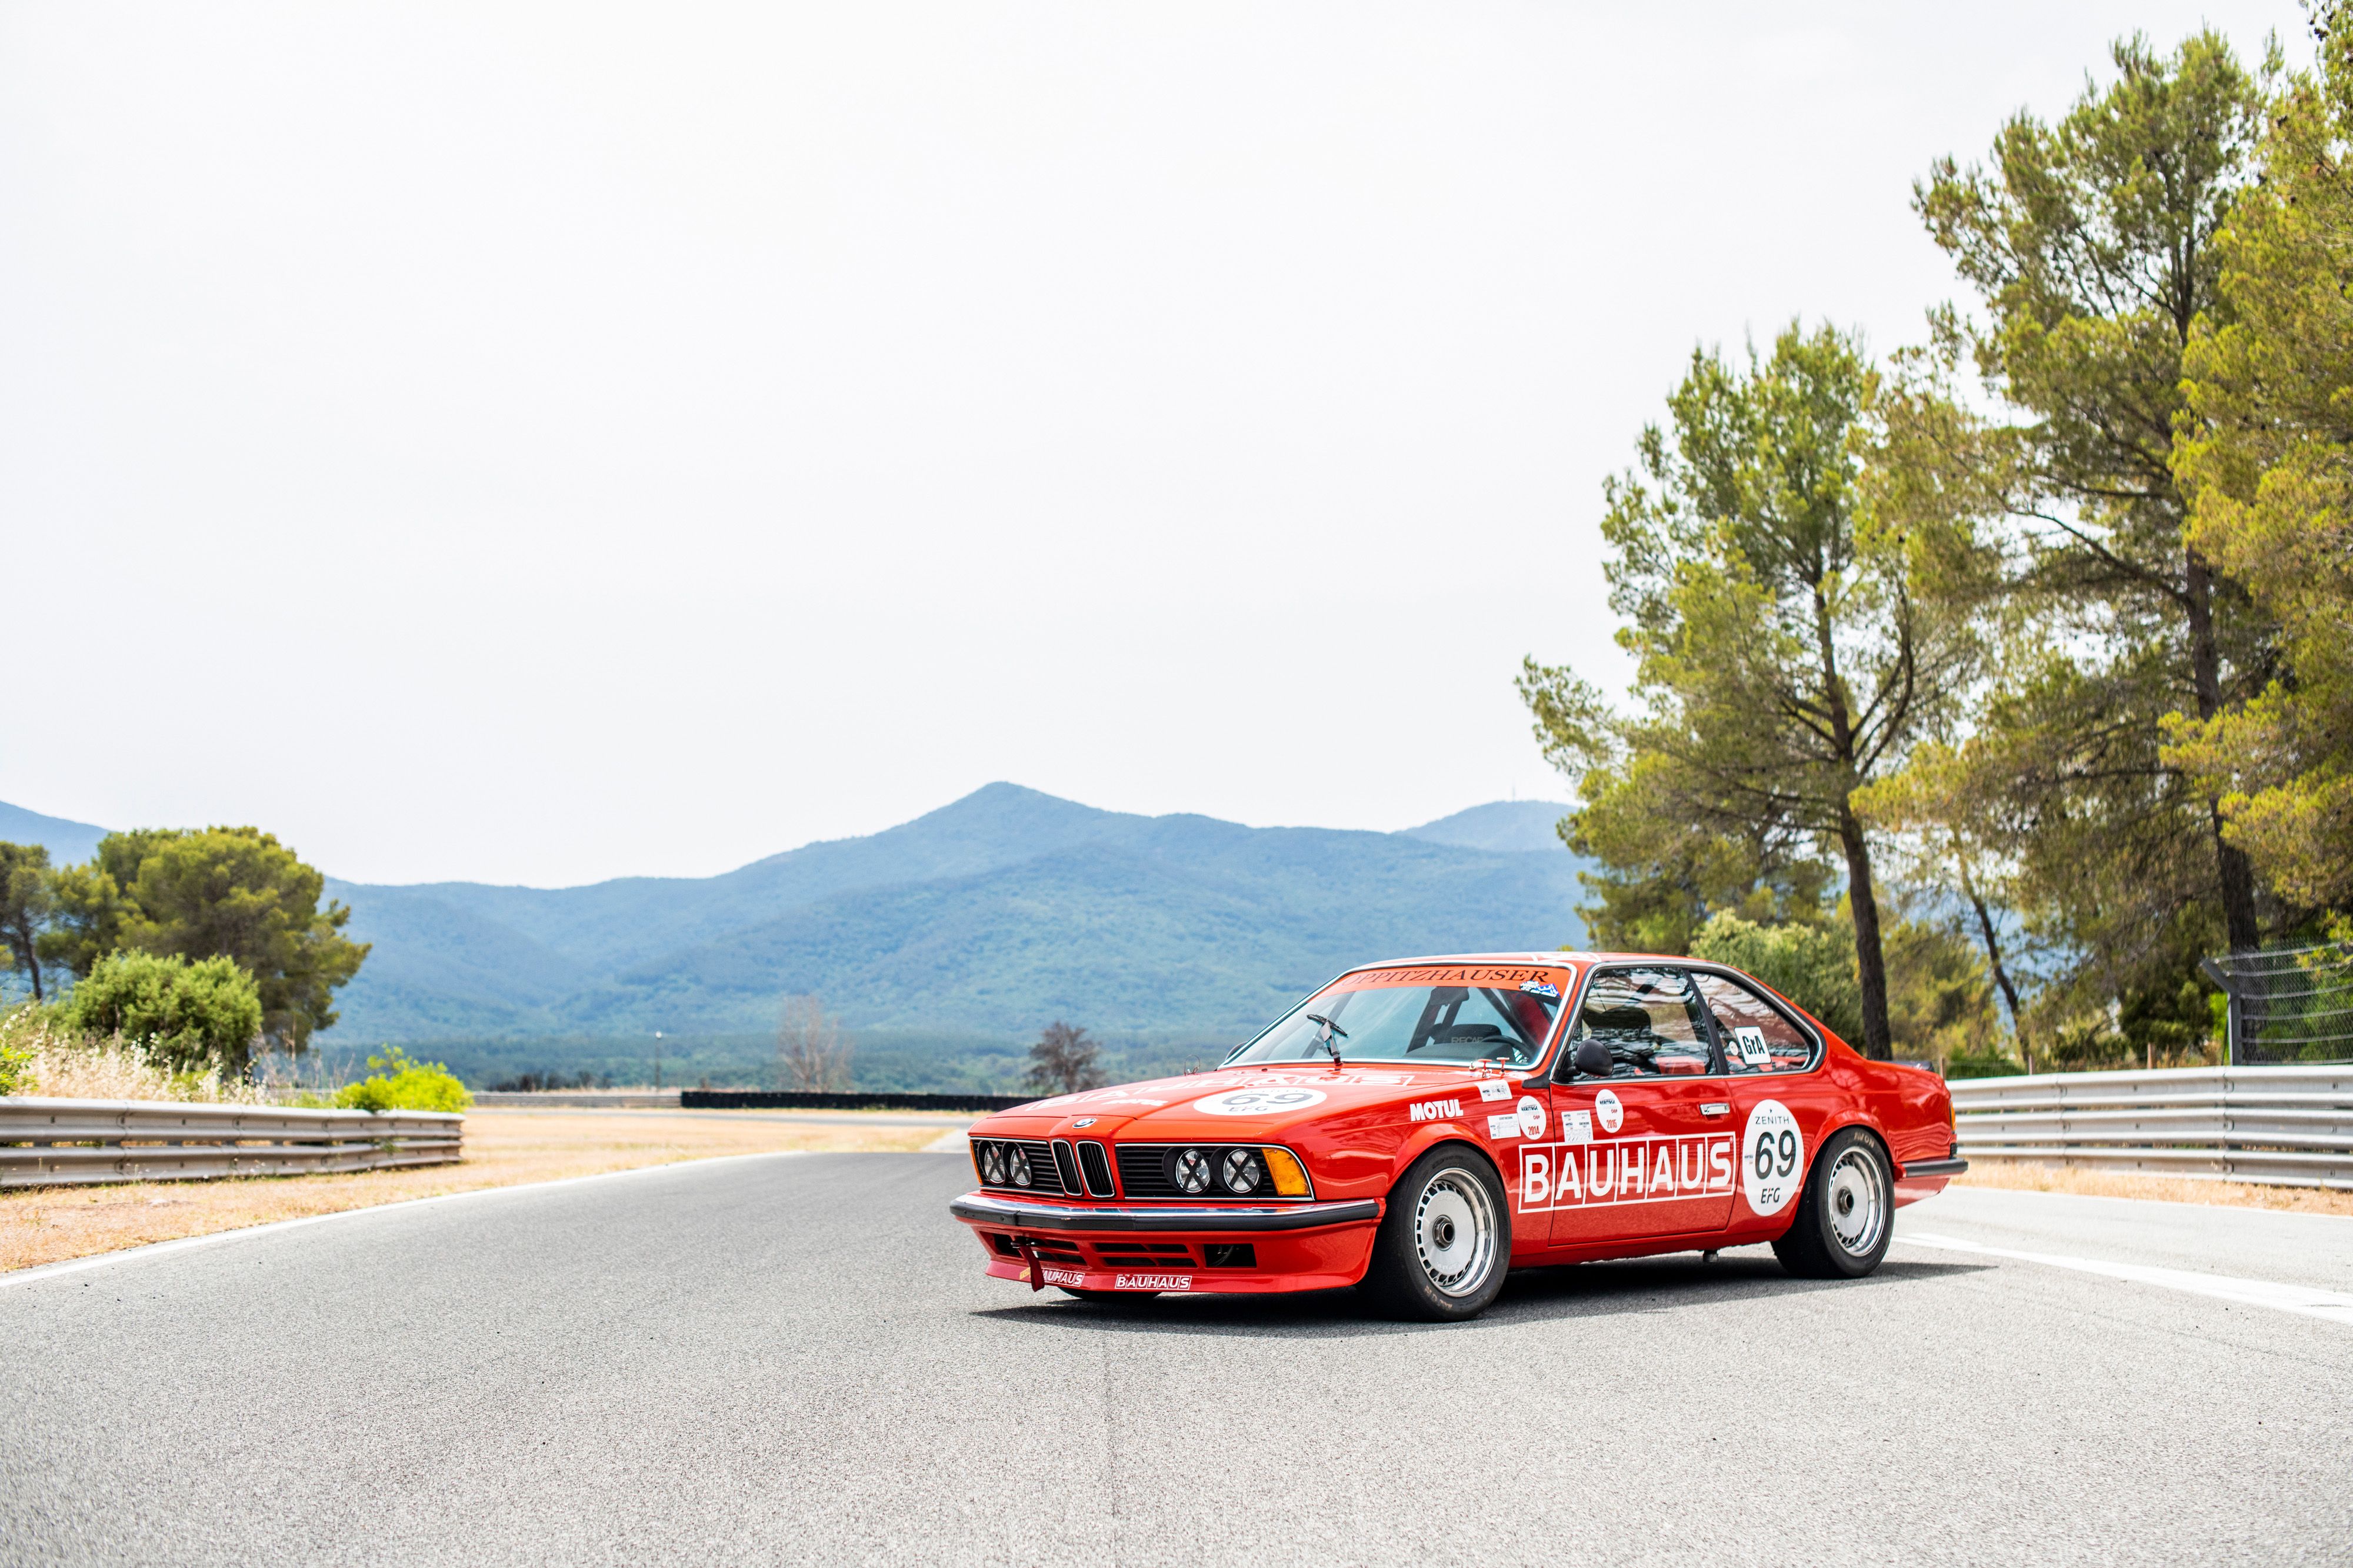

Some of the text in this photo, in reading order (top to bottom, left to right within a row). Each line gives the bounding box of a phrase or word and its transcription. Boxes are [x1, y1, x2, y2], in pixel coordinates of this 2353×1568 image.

[1342, 969, 1549, 986] OPPITZHAUSER
[1742, 1035, 1765, 1055] GrA
[1222, 1093, 1313, 1106] 69
[1409, 1099, 1464, 1122] MOTUL
[1755, 1116, 1789, 1125] ZENITH
[1528, 1125, 1540, 1136] 2014
[1854, 1132, 1875, 1148] AVON
[1755, 1129, 1797, 1180] 69
[1524, 1141, 1732, 1203] BAUHAUS
[1761, 1188, 1780, 1204] EFG
[1043, 1269, 1083, 1286] AUHAUS
[1116, 1275, 1190, 1289] BAUHAUS
